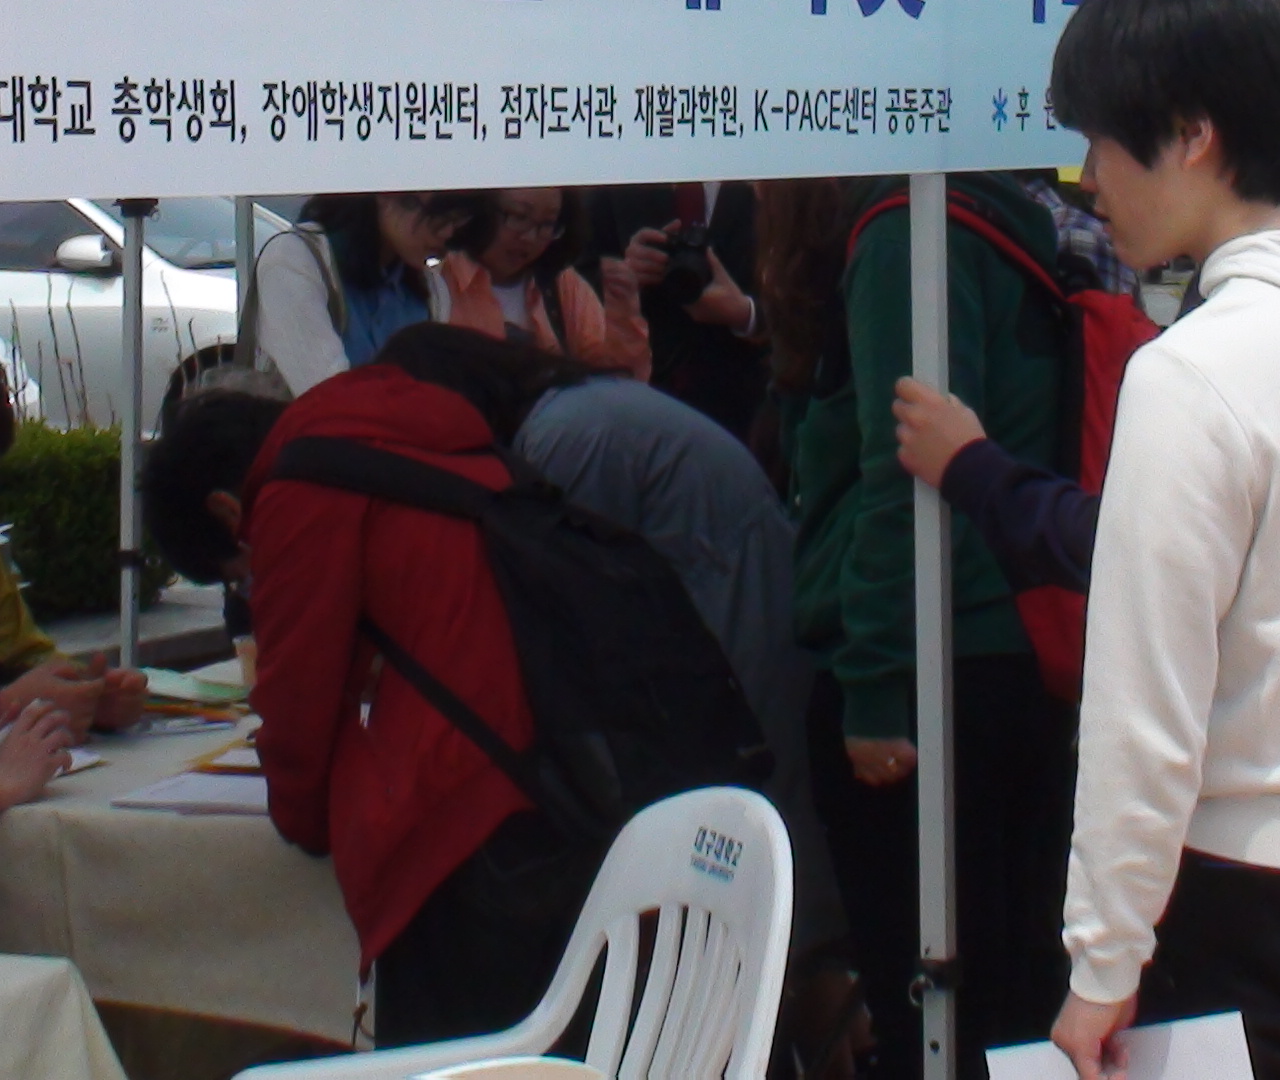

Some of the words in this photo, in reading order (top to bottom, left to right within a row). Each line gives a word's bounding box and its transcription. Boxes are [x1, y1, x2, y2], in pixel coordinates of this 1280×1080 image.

[111, 74, 247, 146] 총학생회,
[261, 79, 488, 144] 장애학생지원센터,
[500, 83, 623, 141] 점자도서관,
[633, 83, 744, 139] 재활과학원,
[754, 86, 877, 136] K-PACE센터
[884, 87, 953, 136] 공동주관
[1016, 86, 1031, 132] 후
